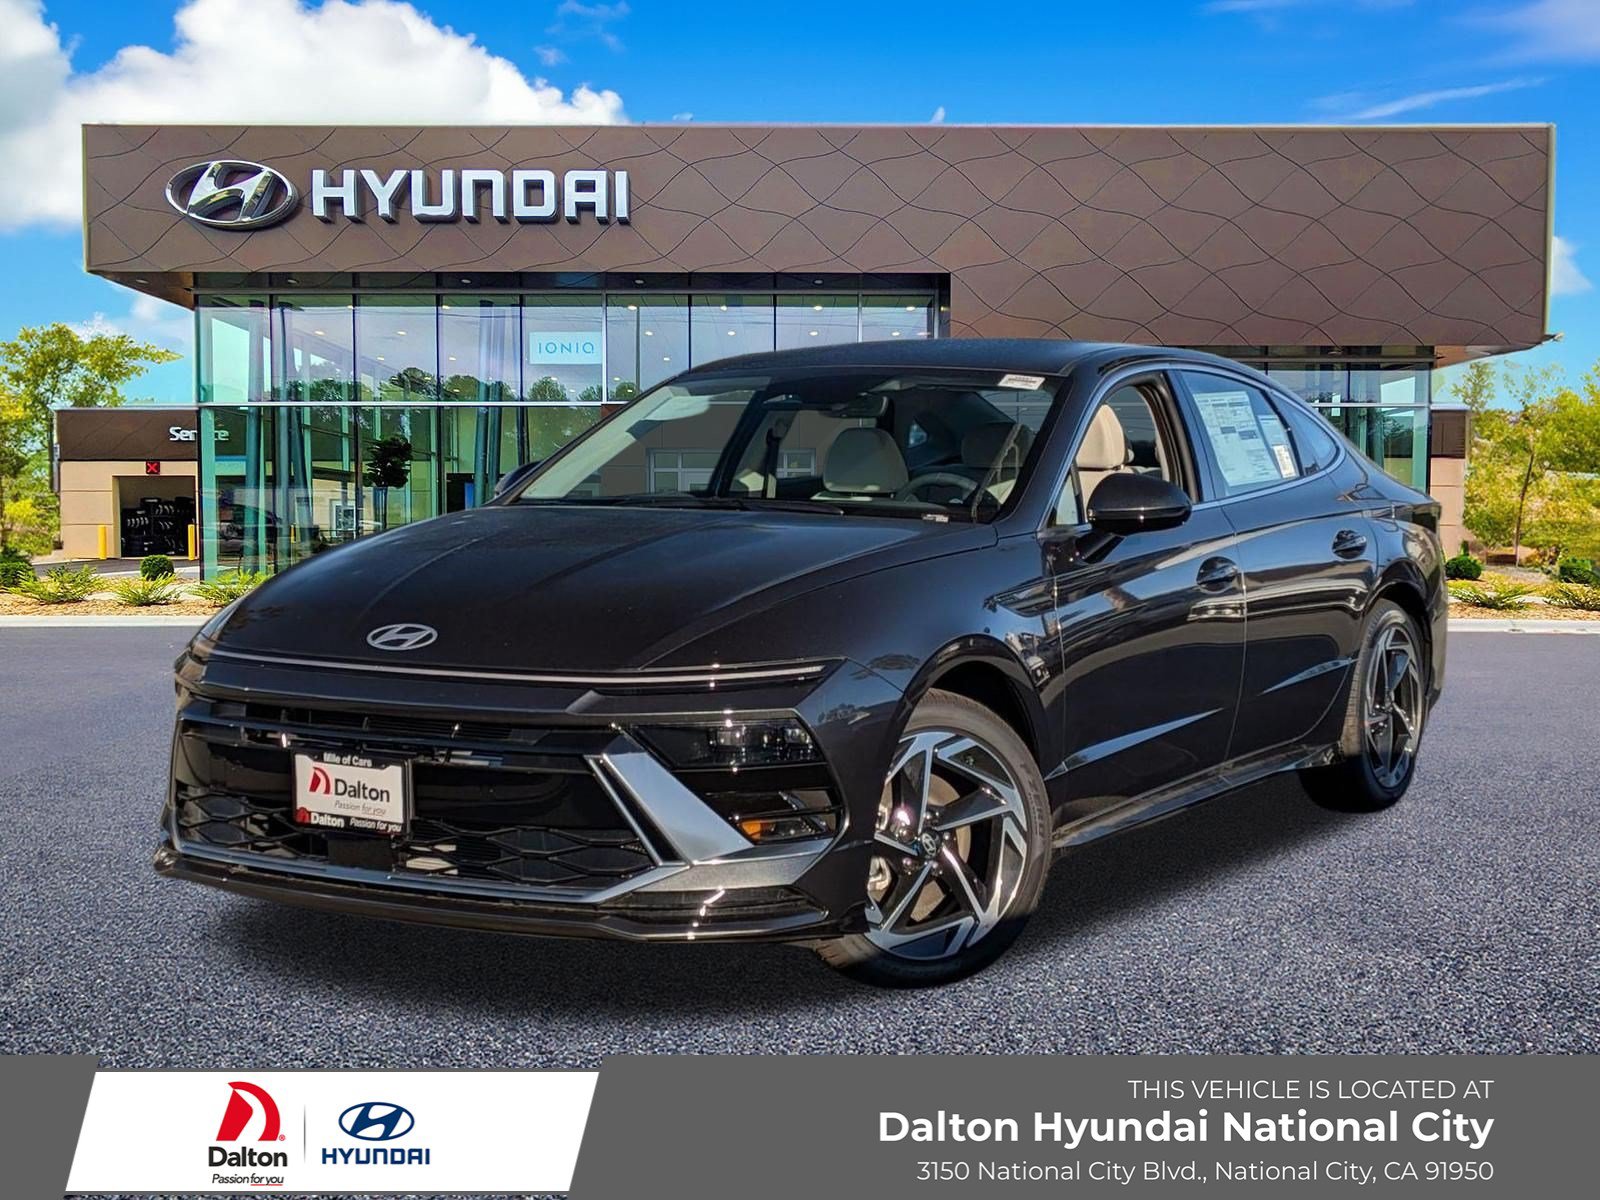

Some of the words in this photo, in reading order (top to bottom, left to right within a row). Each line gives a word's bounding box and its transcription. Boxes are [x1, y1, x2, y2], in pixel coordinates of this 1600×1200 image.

[312, 169, 631, 221] HYUNDAI
[538, 342, 594, 354] IONIQ
[168, 426, 230, 441] Sere
[342, 754, 351, 764] of
[352, 755, 373, 768] Cars
[334, 778, 391, 803] Dalton
[335, 800, 361, 811] Passion
[361, 802, 373, 812] for
[373, 806, 387, 816] you
[310, 812, 345, 828] Dalton
[349, 817, 377, 829] Passion
[376, 820, 388, 830] for
[388, 824, 402, 833] you
